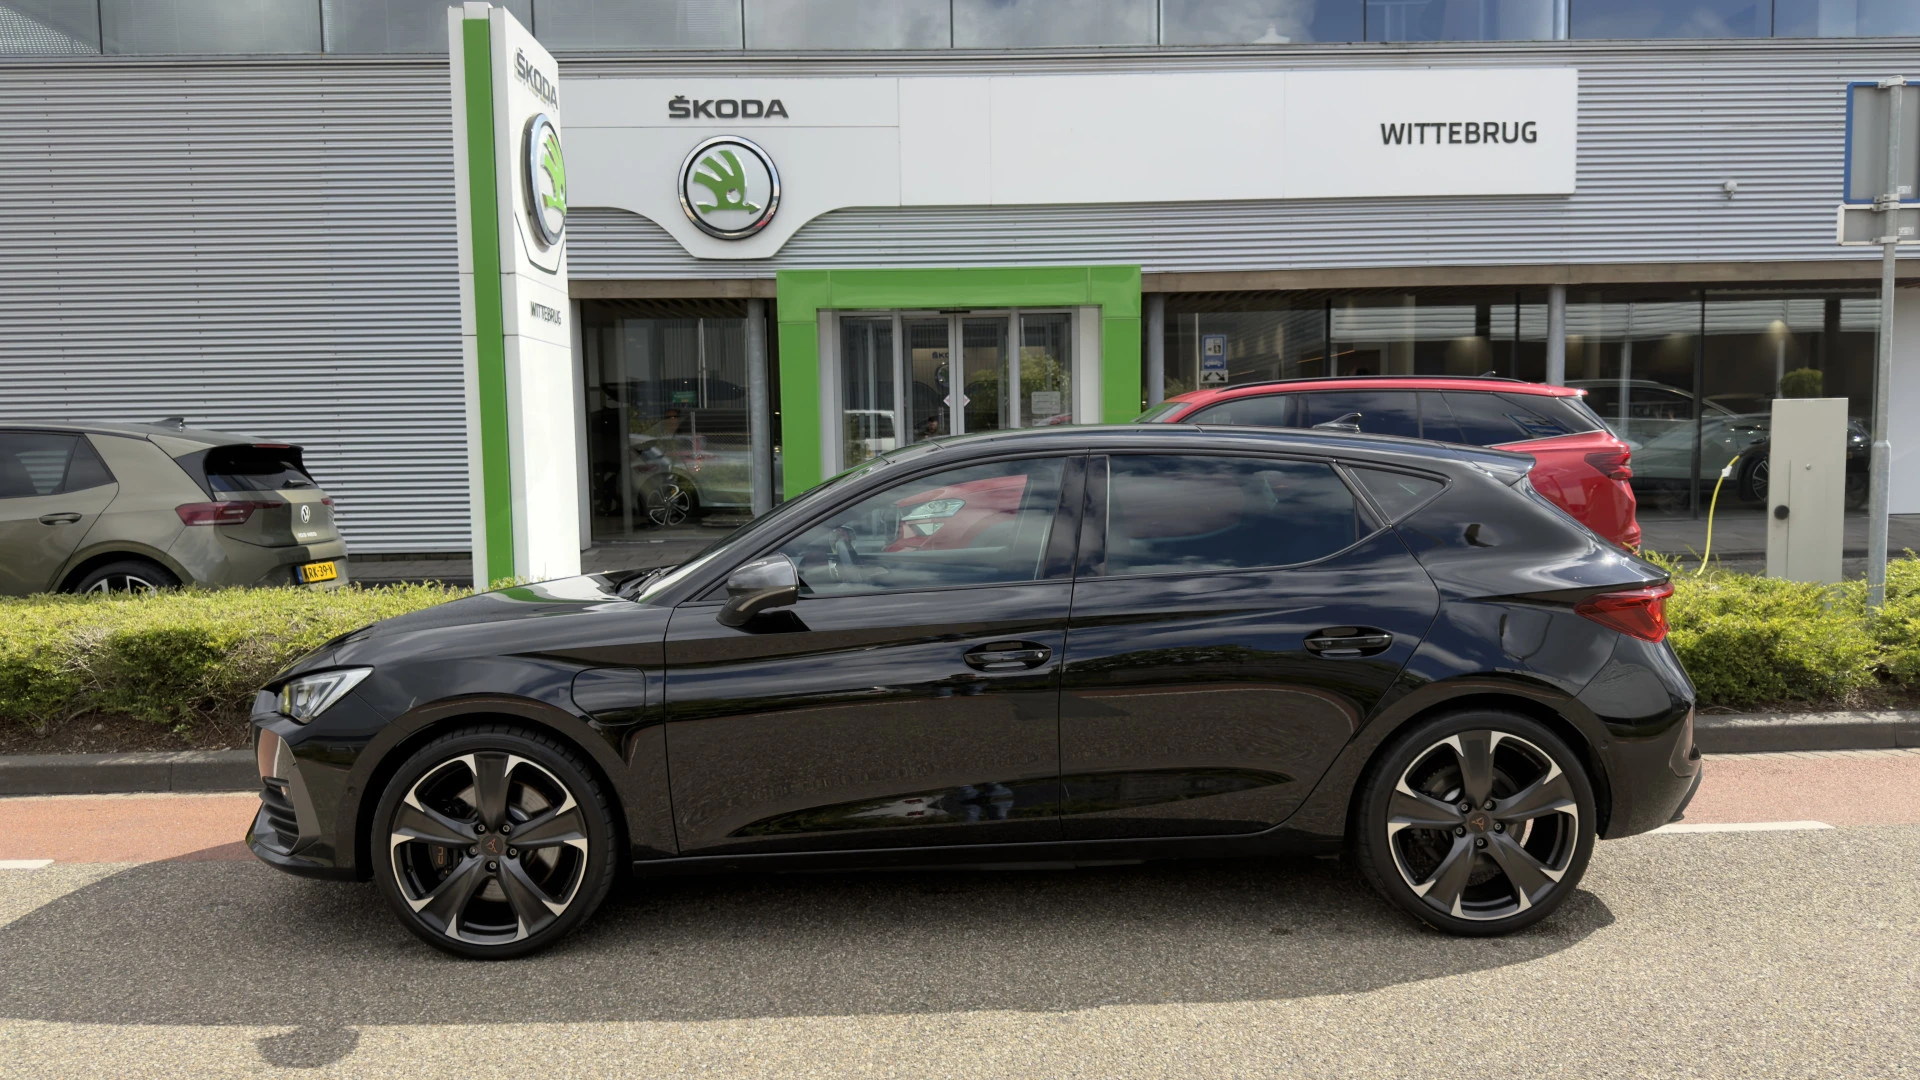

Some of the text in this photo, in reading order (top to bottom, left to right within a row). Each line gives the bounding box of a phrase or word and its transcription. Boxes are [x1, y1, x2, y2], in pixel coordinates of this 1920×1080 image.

[516, 47, 558, 110] ŠKODA
[668, 95, 789, 119] ŠKODA
[1380, 121, 1538, 146] WITTEBRUG
[530, 300, 561, 326] WITTEBRUG
